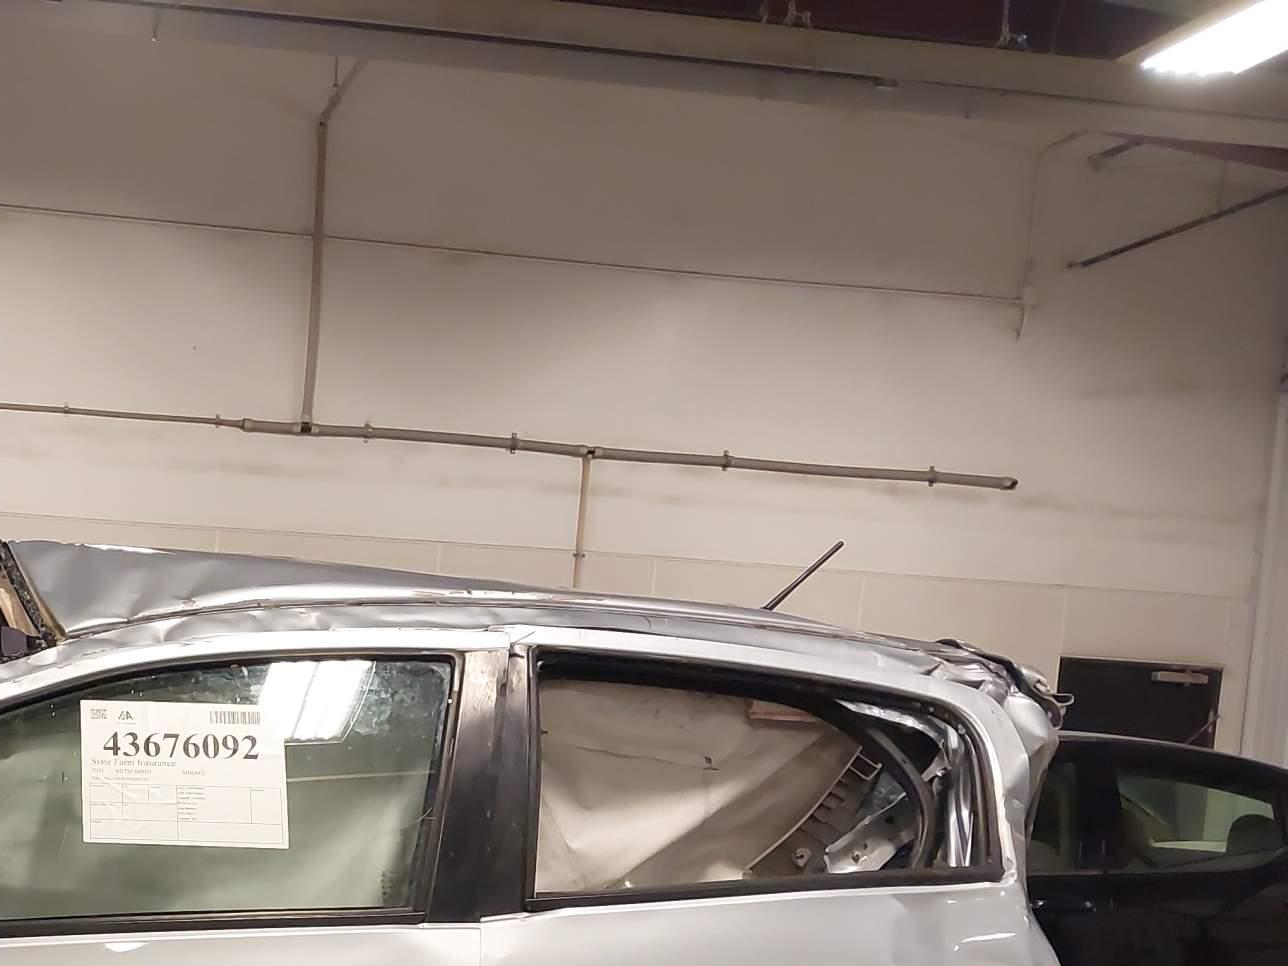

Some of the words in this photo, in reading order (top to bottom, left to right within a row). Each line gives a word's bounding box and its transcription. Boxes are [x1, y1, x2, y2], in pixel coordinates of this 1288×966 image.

[103, 731, 259, 760] 43676092
[91, 757, 111, 767] State
[114, 758, 135, 767] Farm
[137, 758, 177, 768] Insurance
